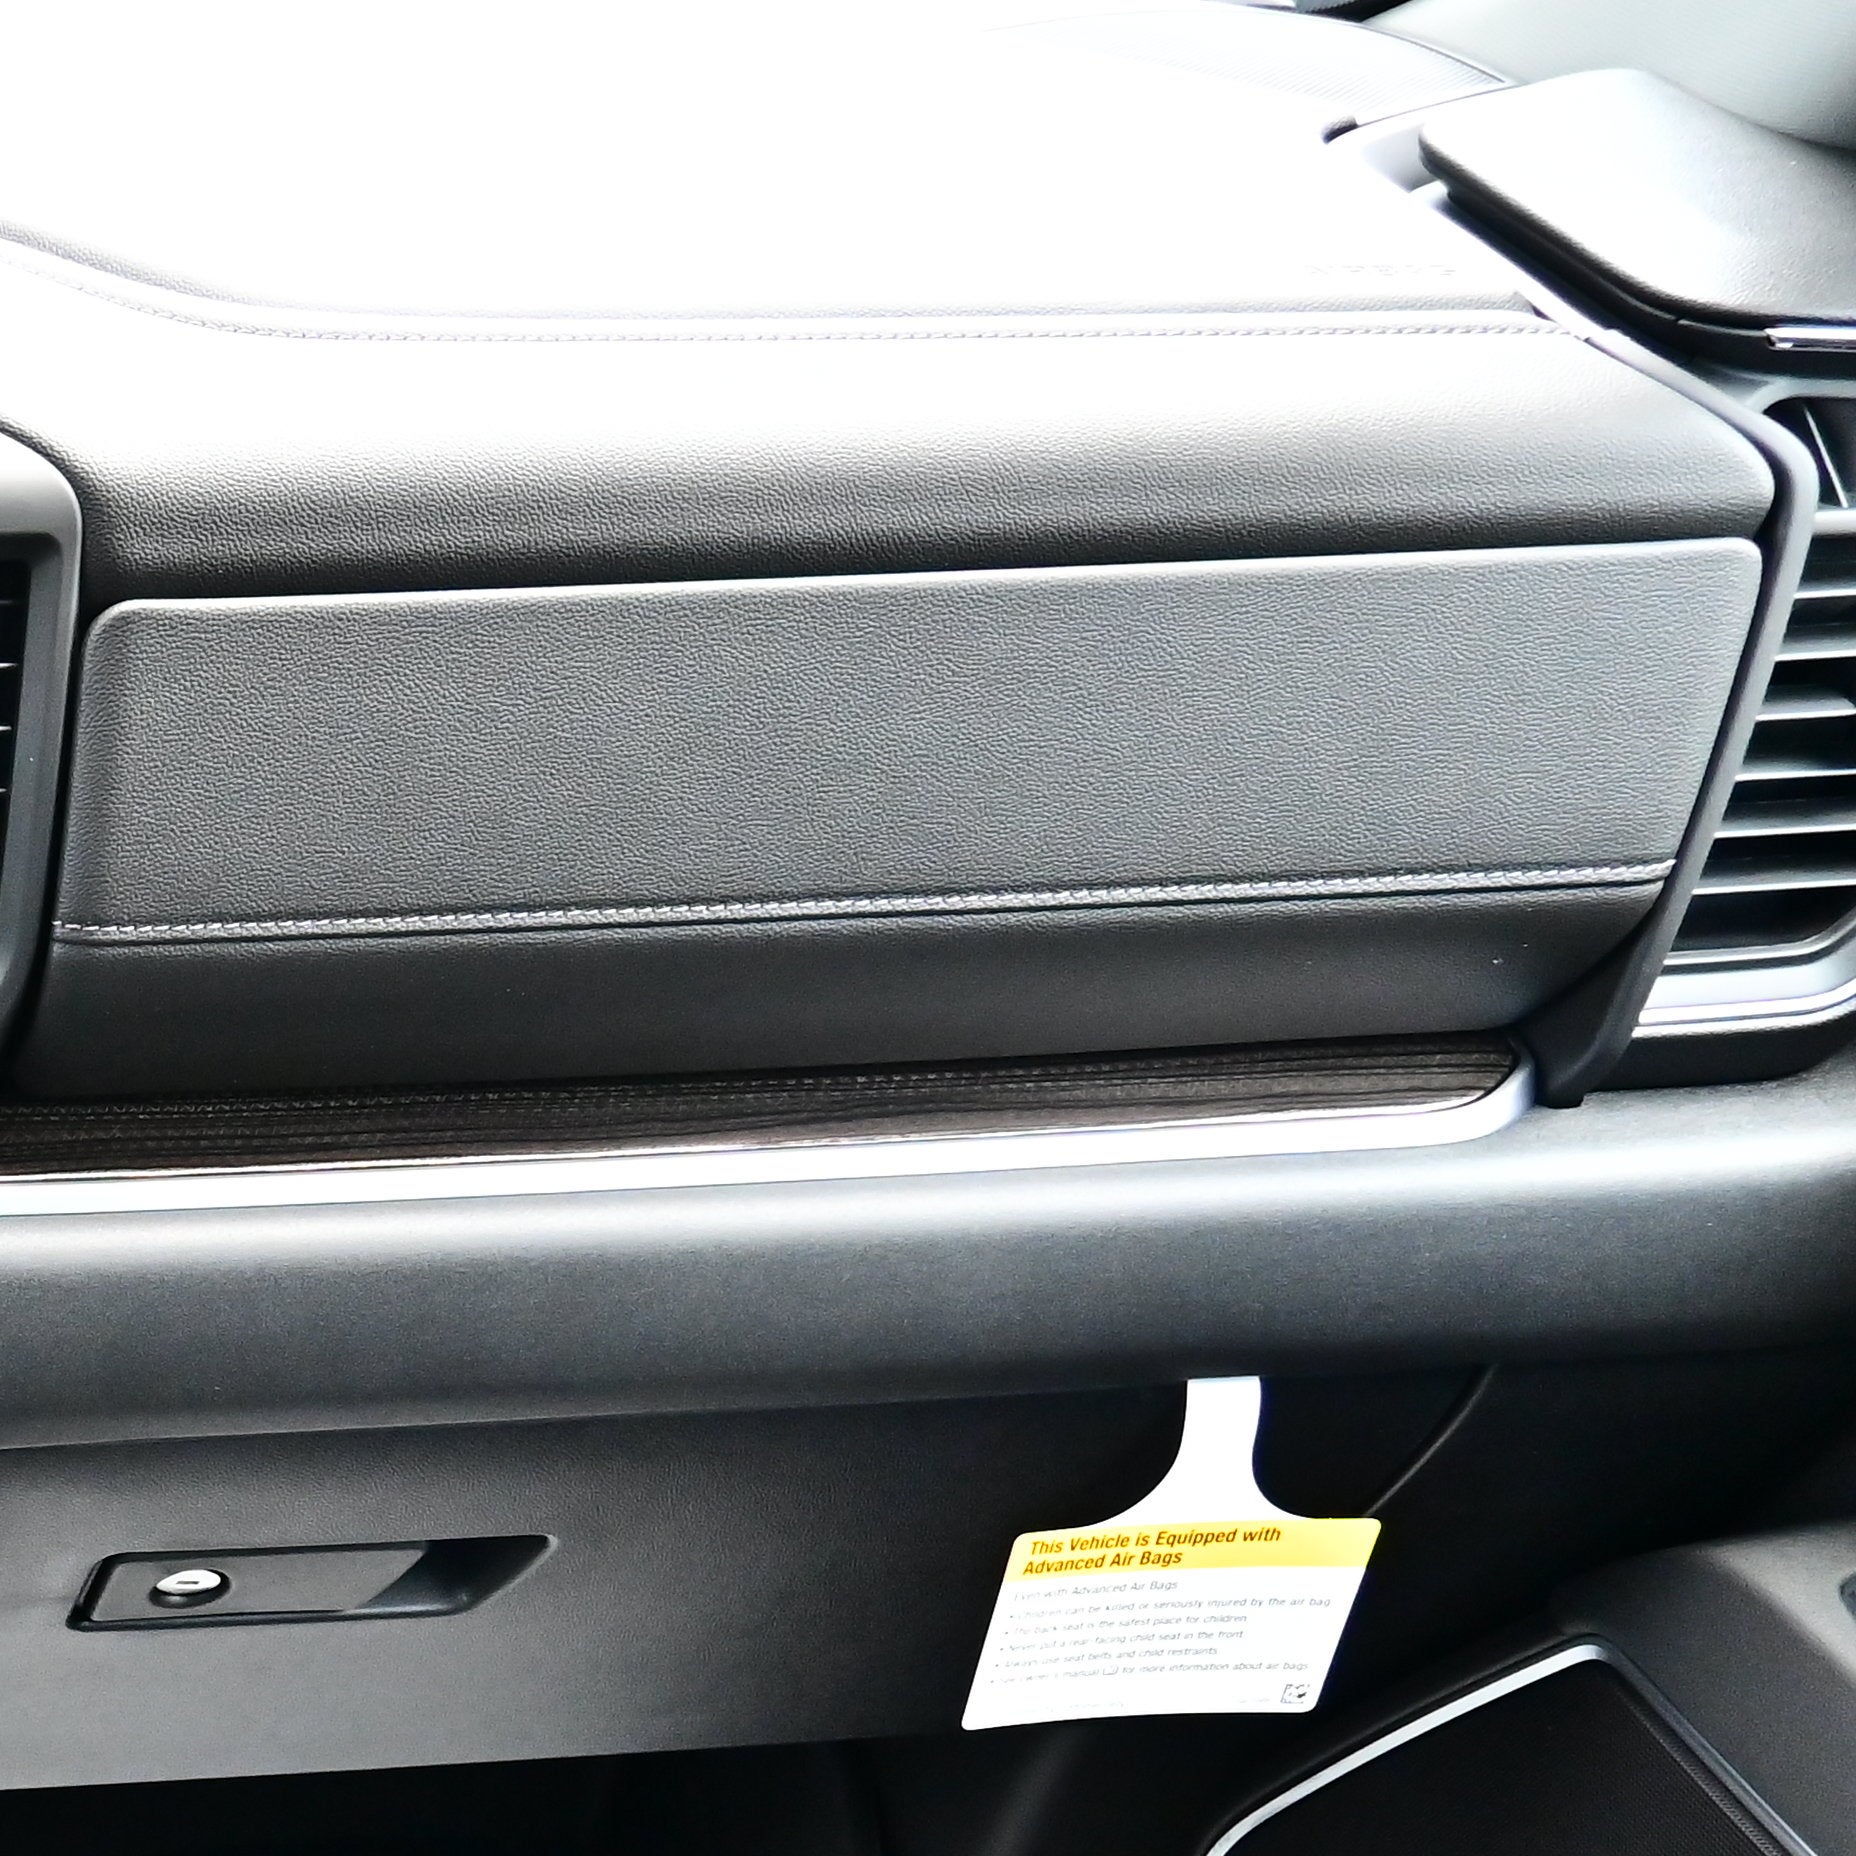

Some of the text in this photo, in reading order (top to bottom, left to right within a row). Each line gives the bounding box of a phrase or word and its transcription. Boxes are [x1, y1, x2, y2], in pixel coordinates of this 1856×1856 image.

[1031, 1526, 1282, 1557] This Vehicle is Equipped with
[1023, 1549, 1184, 1576] Advanced Air Bags
